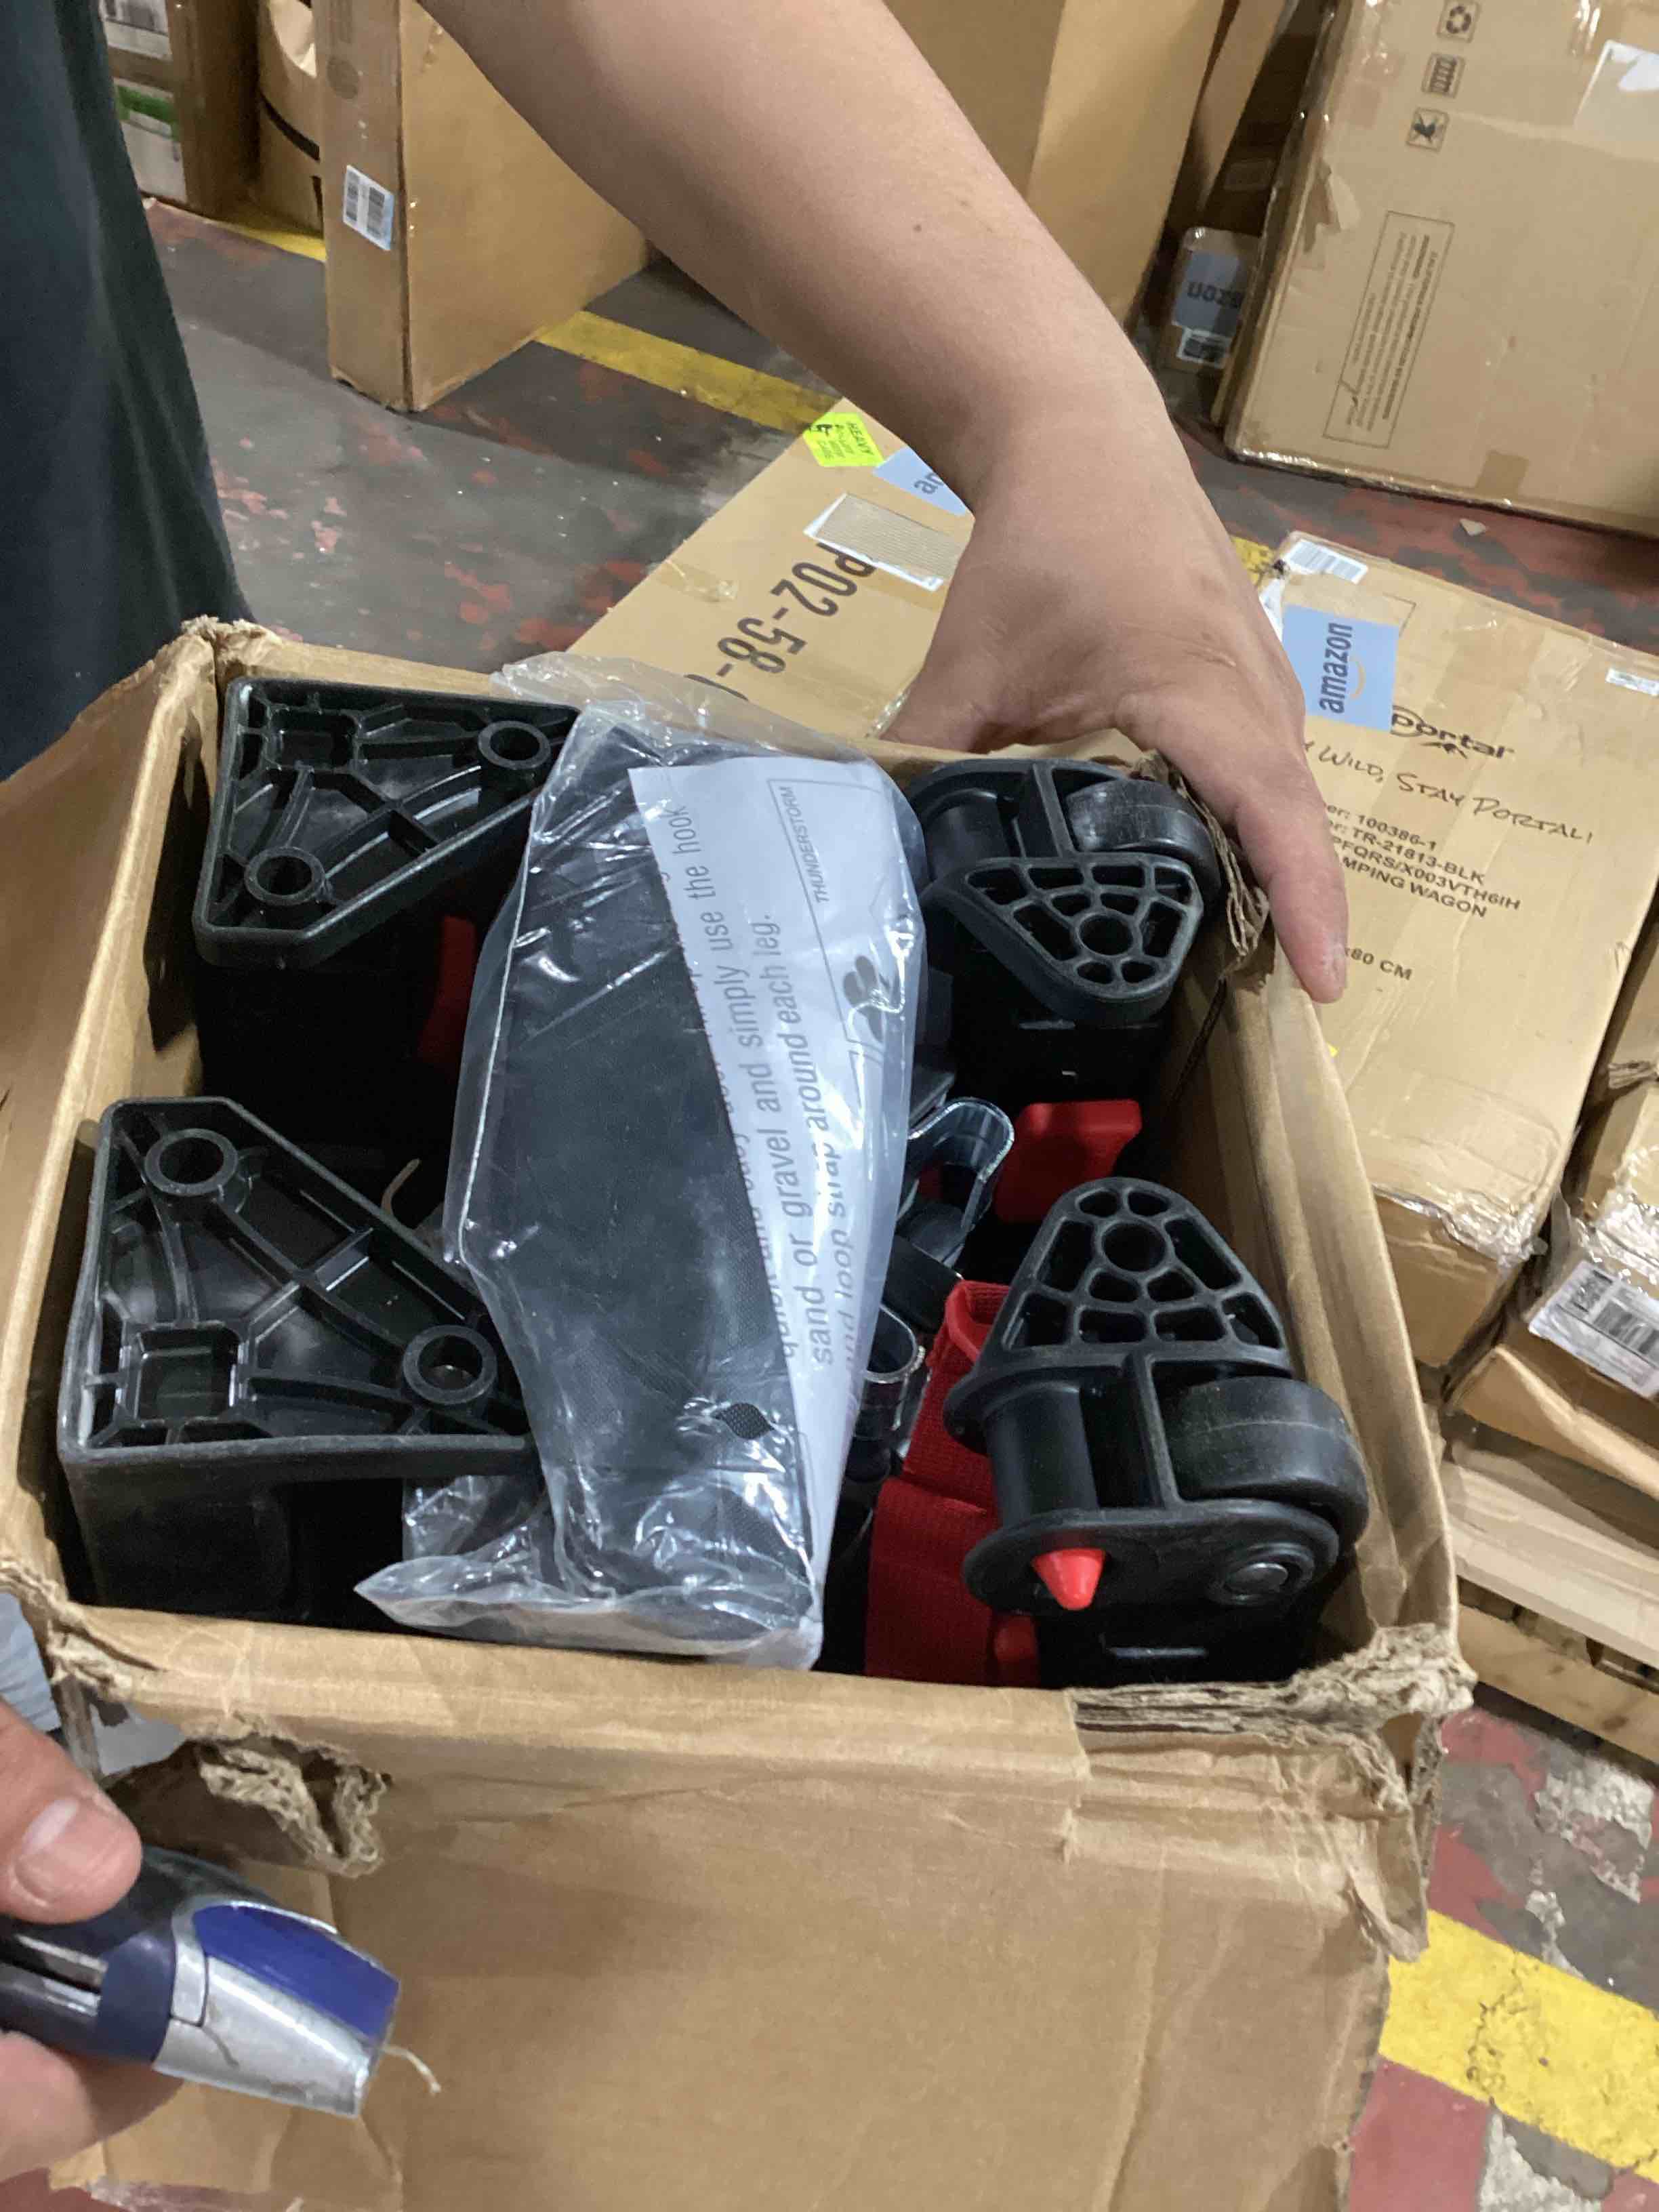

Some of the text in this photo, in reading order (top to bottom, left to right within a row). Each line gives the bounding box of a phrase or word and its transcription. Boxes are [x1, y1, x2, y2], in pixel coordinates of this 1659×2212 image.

[683, 542, 876, 701] P02-58-
[1319, 622, 1353, 714] amazon
[660, 804, 702, 855] hook
[779, 786, 830, 903] THUNDERSTORM
[1352, 826, 1486, 886] TR-21813-BLK
[1357, 814, 1437, 852] 100386-1
[683, 864, 716, 900] the
[1341, 855, 1488, 918] MPING WAGON
[700, 911, 733, 951] use
[750, 914, 781, 956] leg.
[759, 964, 802, 1024] each
[1379, 959, 1412, 981] CM
[713, 965, 764, 1048] simply
[739, 1062, 782, 1113] and
[777, 1032, 828, 1131] around
[756, 1128, 814, 1218] gravel
[789, 1232, 818, 1267] or
[832, 1228, 855, 1298] loop
[794, 1286, 834, 1365] sand
